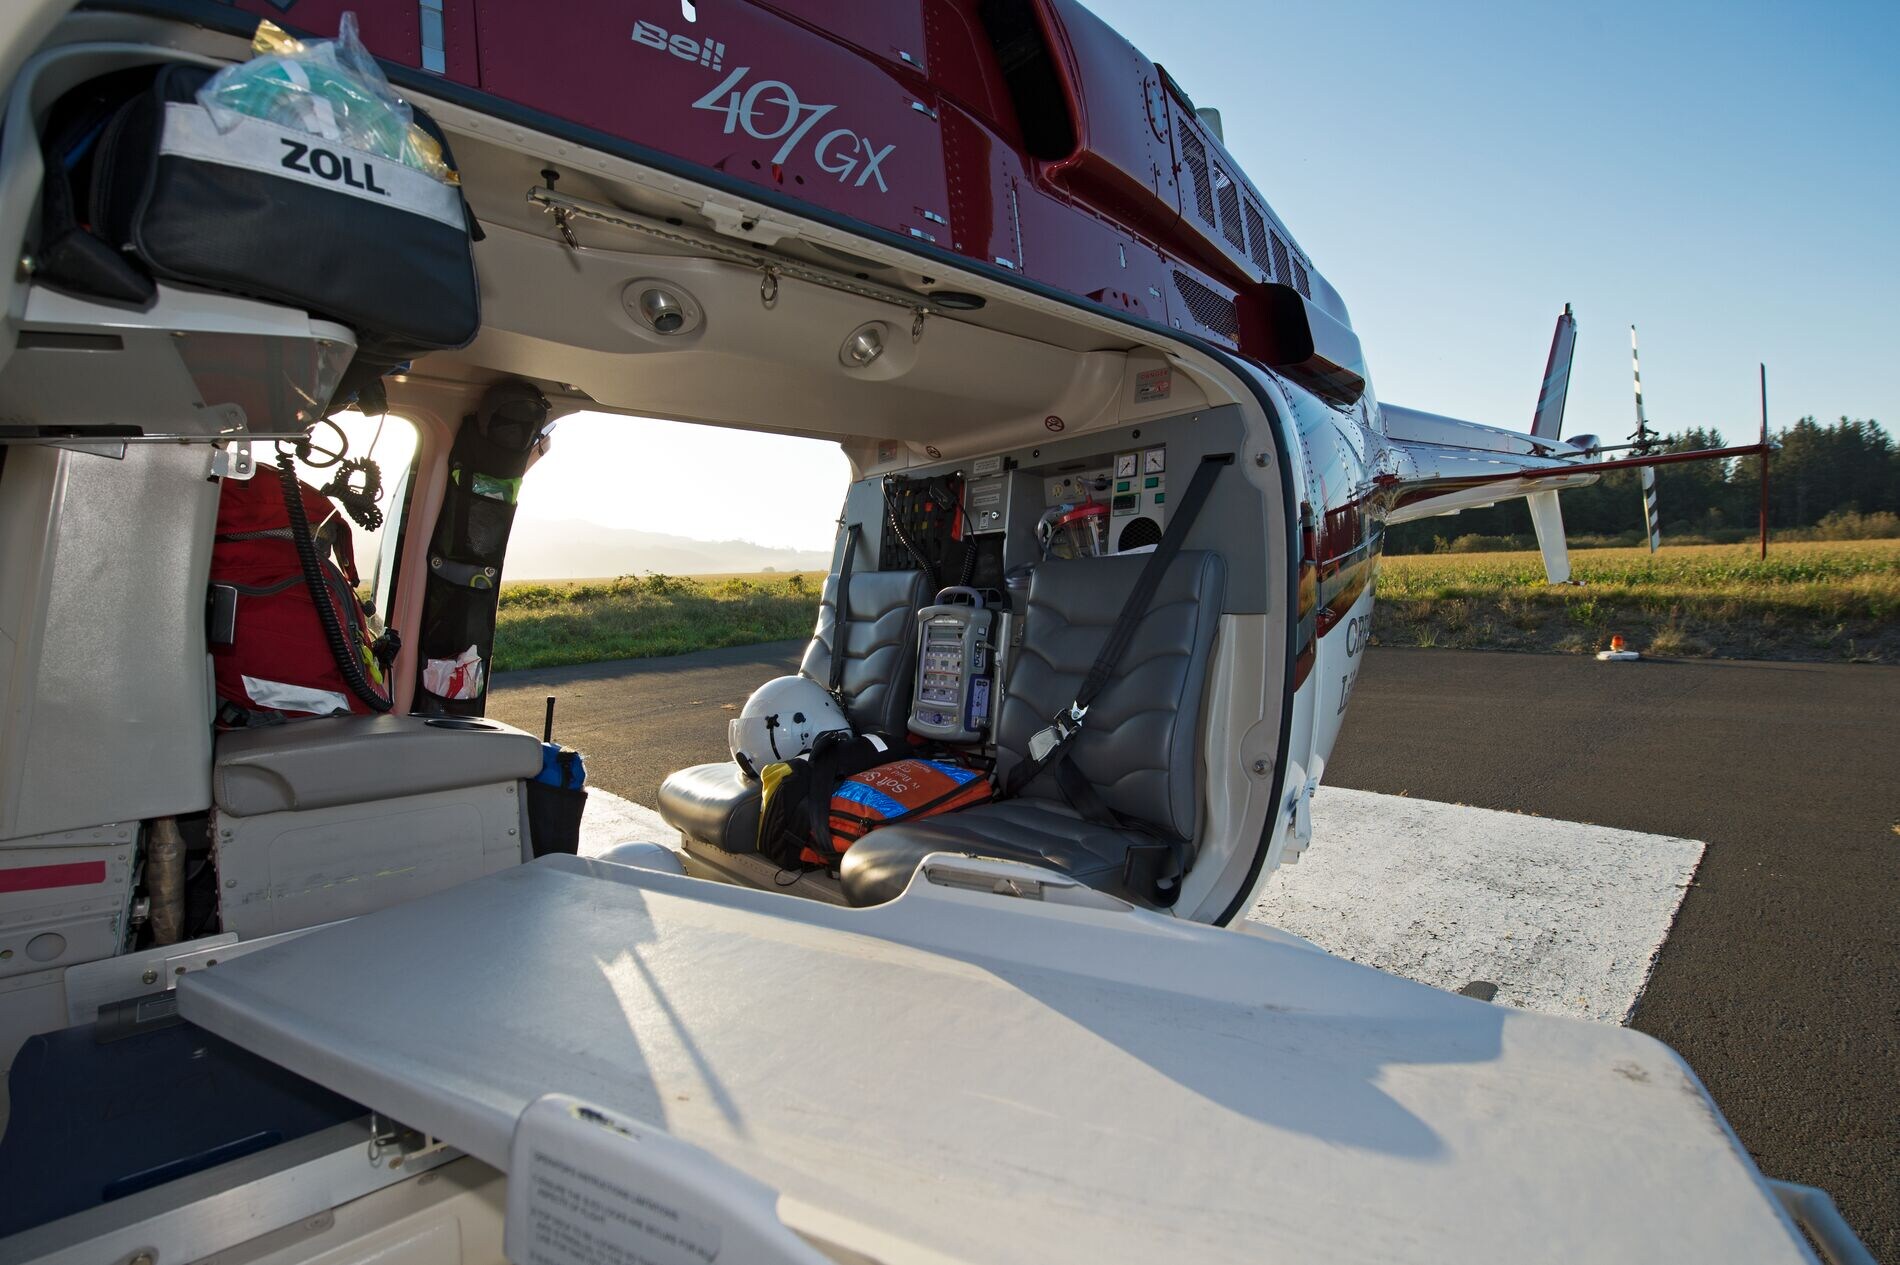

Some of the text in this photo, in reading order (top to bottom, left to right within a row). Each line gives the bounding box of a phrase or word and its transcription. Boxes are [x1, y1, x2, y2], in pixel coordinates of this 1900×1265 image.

[631, 19, 726, 73] Bell
[691, 66, 897, 193] 407 GX
[280, 137, 386, 196] ZOLL
